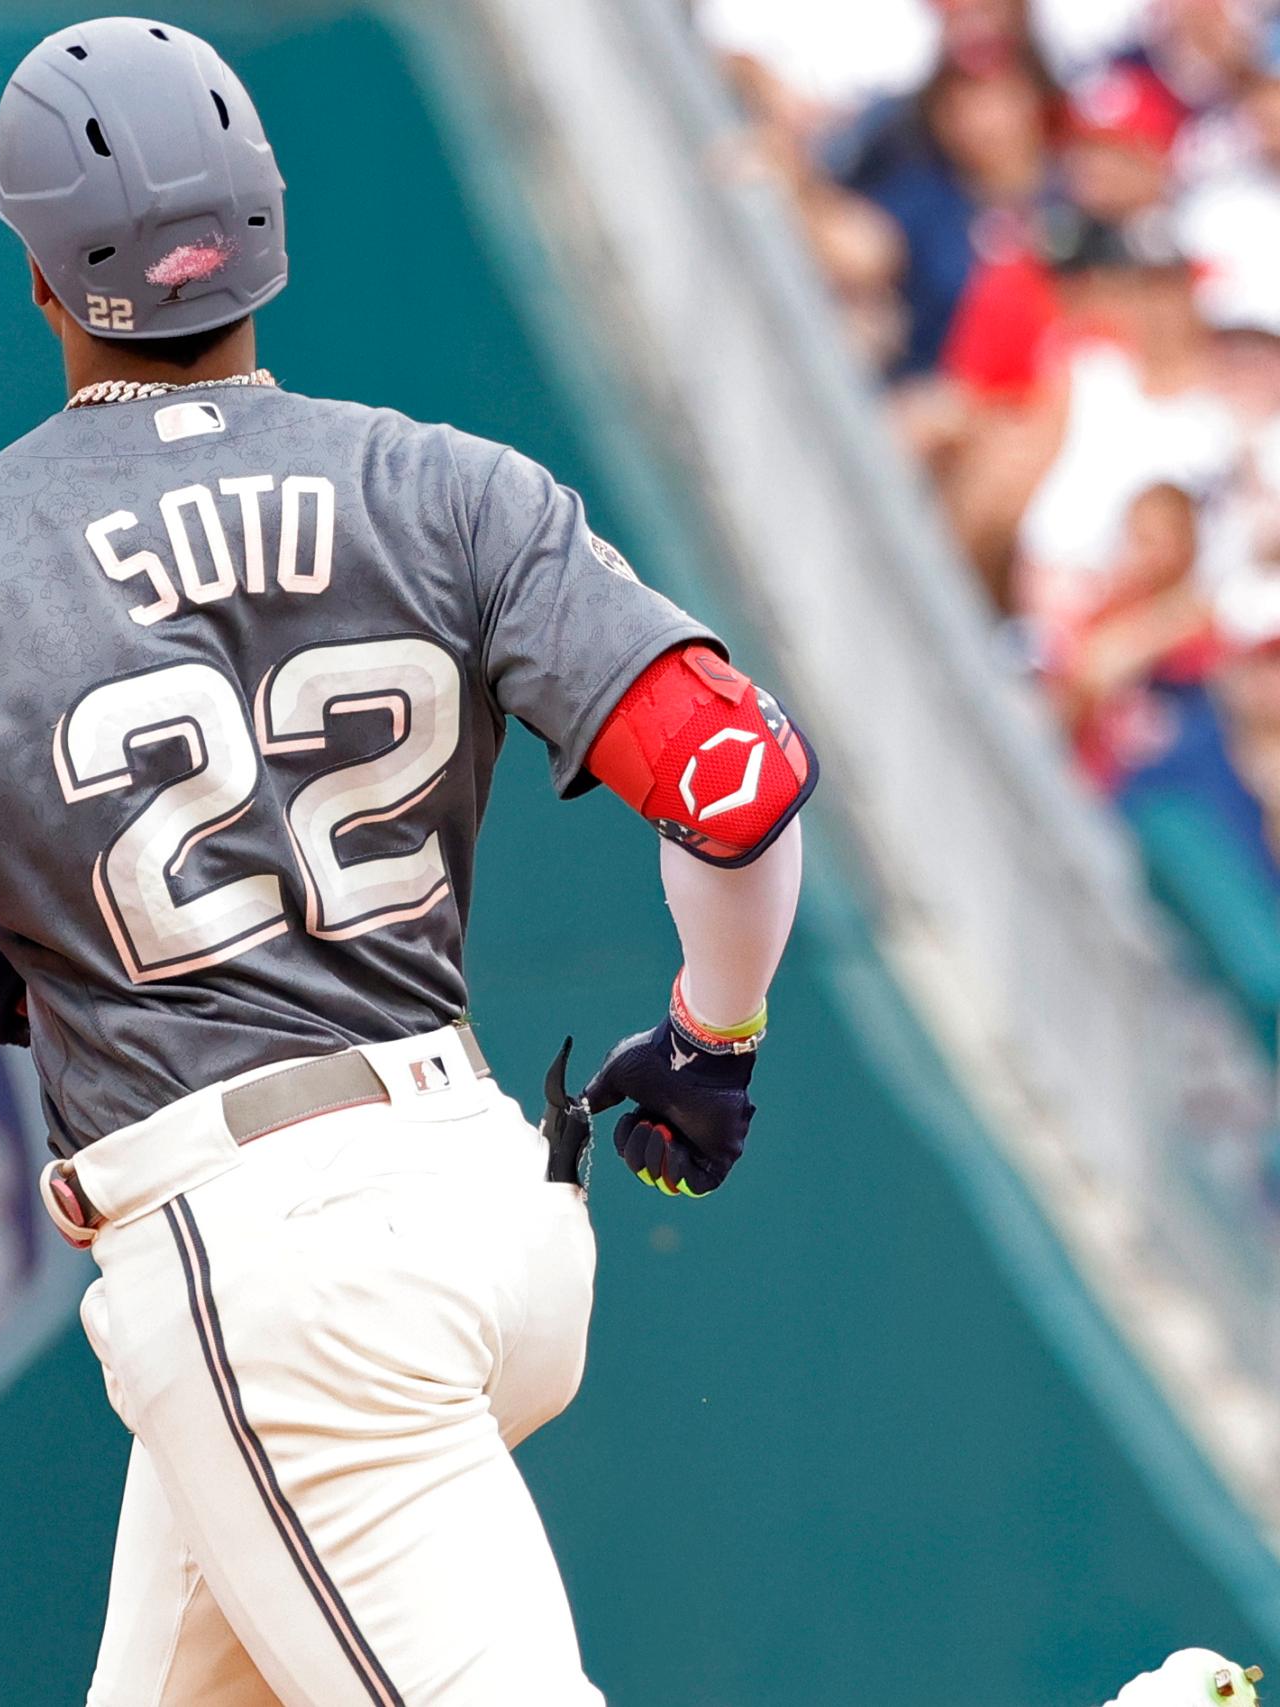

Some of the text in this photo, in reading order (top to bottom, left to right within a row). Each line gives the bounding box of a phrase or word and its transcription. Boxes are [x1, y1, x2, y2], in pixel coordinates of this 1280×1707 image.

[86, 293, 134, 331] 22
[85, 474, 335, 626] SOTO
[52, 634, 462, 984] 22
